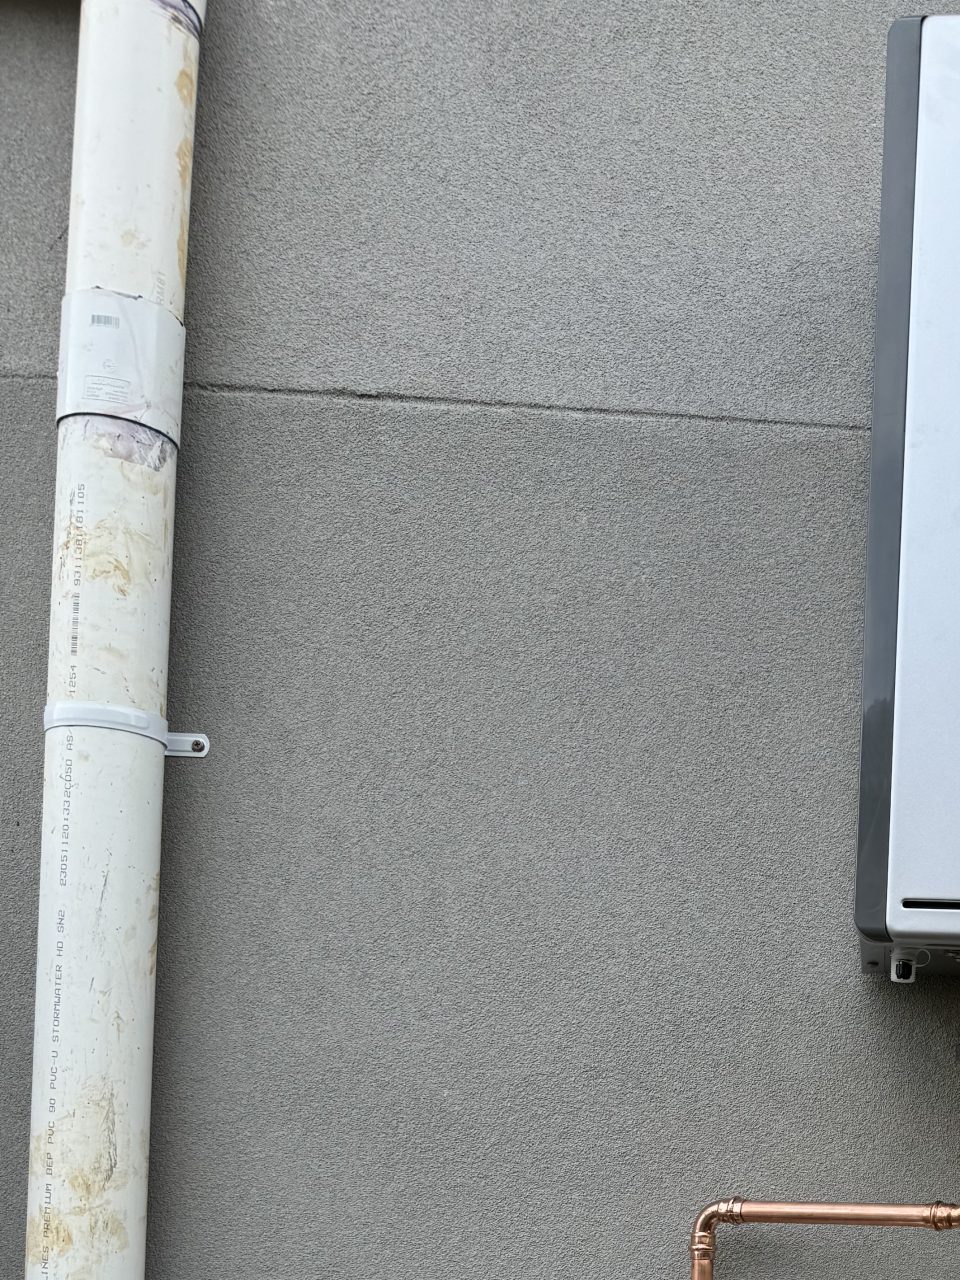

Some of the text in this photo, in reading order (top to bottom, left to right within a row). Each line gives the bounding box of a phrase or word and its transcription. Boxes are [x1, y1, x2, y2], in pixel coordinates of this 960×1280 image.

[57, 909, 66, 933] SN2
[56, 941, 64, 957] HD
[51, 964, 63, 1043] STORMWATER
[50, 1050, 59, 1090] PVC-U
[48, 1098, 56, 1113] 90
[43, 1183, 52, 1238] PREMIUM
